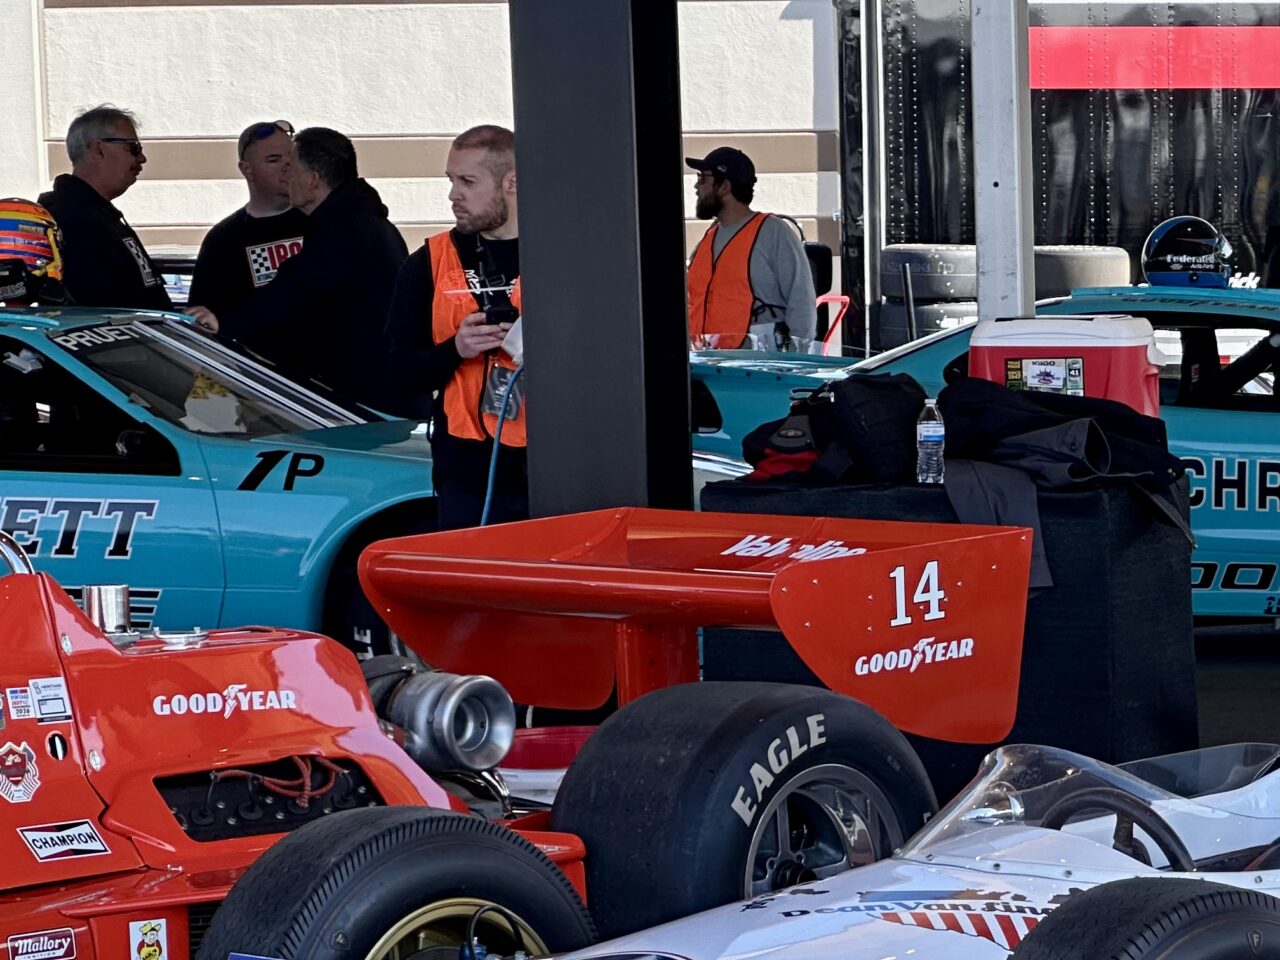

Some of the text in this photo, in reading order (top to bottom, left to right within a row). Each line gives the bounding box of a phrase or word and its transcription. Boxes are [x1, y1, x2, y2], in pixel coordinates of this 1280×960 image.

[889, 560, 946, 628] 14
[731, 713, 827, 827] EAGLE
[31, 831, 97, 850] CHAMPION
[894, 901, 977, 912] Van
[15, 936, 71, 955] Mallory
